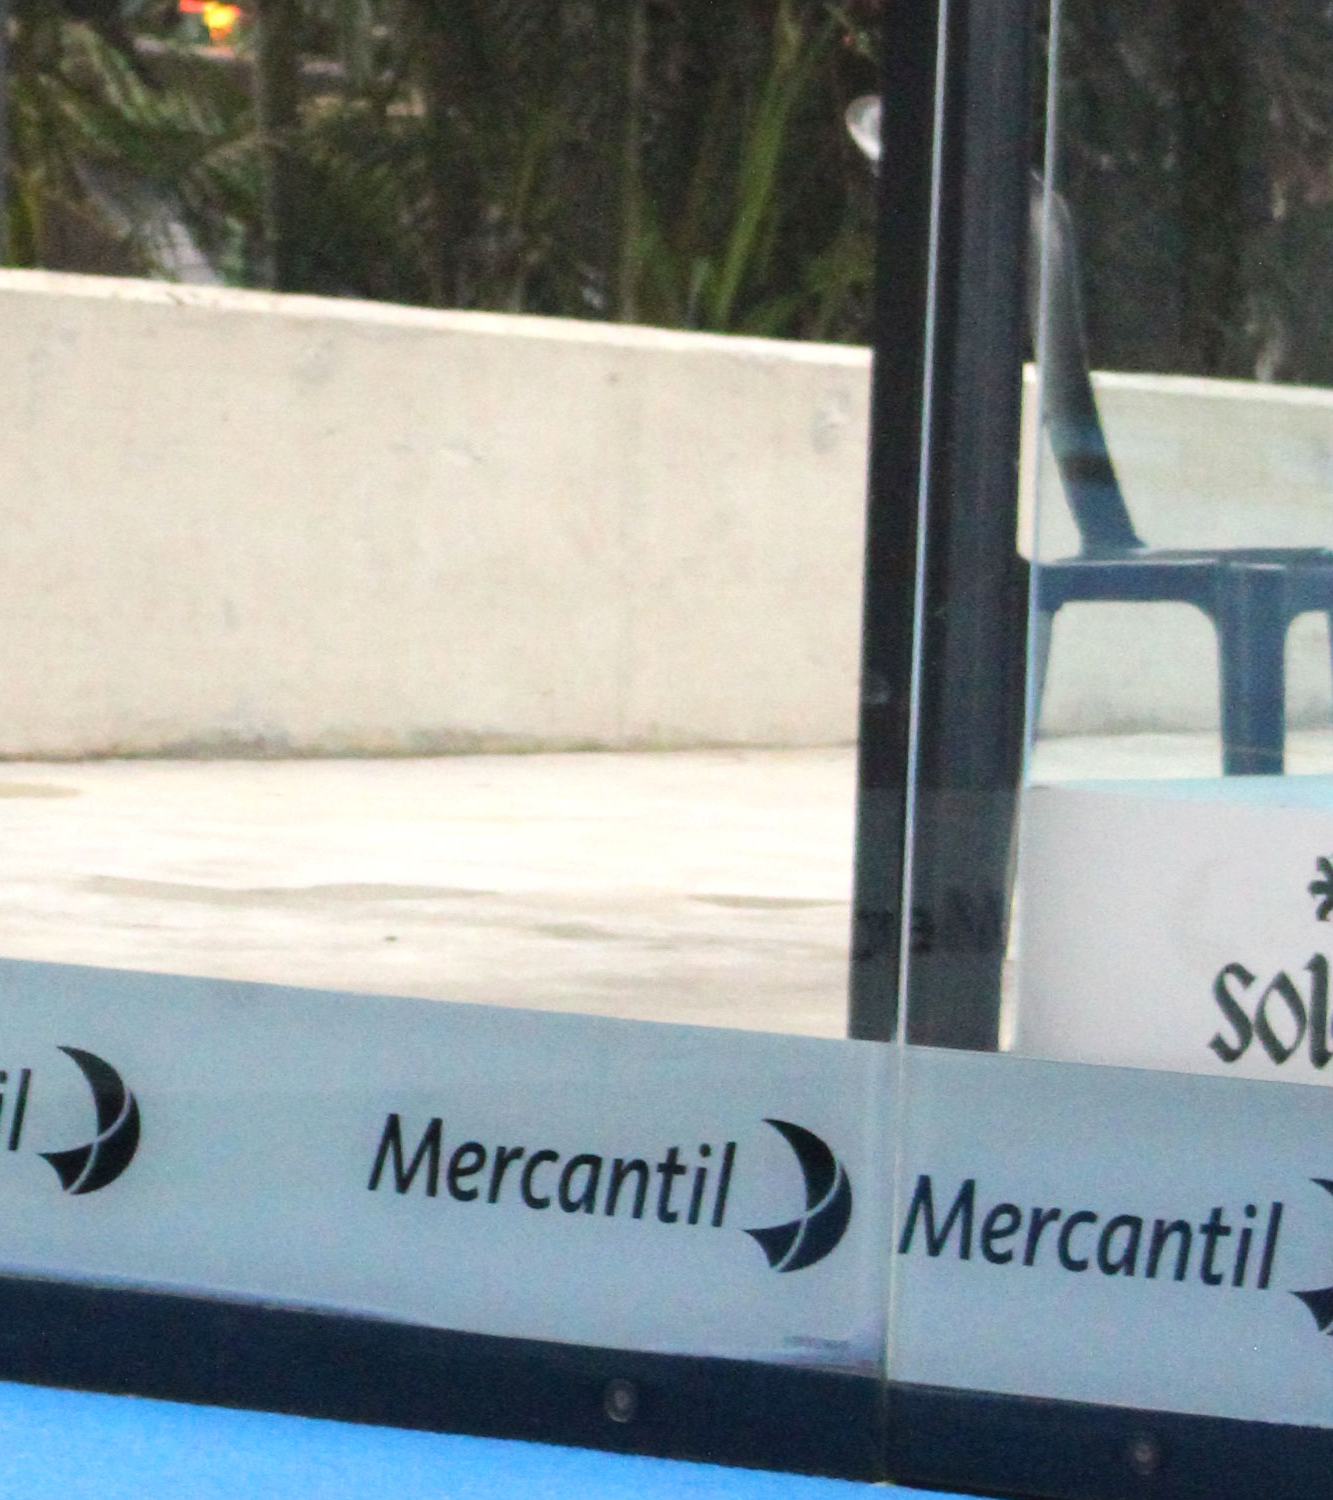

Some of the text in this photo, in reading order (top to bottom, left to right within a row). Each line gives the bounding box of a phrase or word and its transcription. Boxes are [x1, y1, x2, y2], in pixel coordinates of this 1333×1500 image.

[1208, 951, 1333, 1069] sol
[368, 1113, 737, 1228] Mercantil
[898, 1175, 1283, 1290] Mercantil
